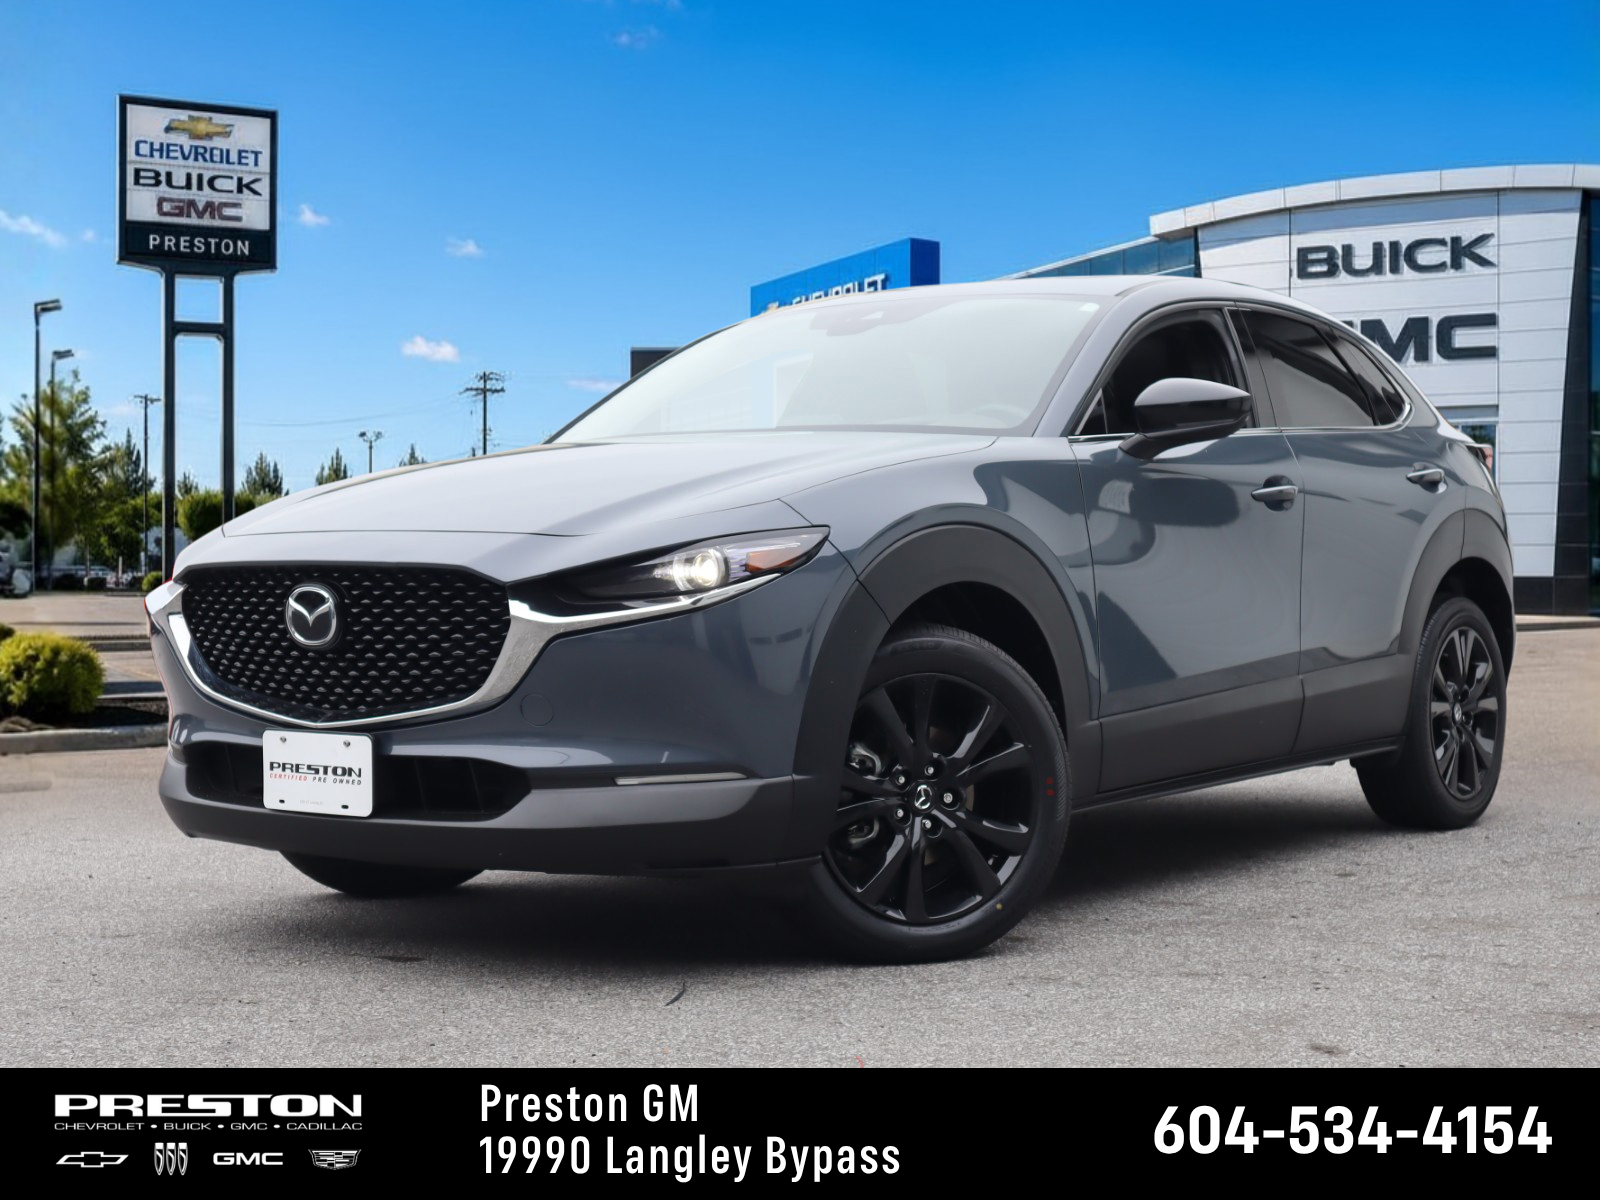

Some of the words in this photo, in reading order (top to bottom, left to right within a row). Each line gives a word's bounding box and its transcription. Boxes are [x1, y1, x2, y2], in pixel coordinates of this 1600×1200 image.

[135, 140, 263, 167] CHEVROLET
[133, 167, 262, 196] BUICK
[157, 196, 243, 222] GMC
[149, 234, 250, 255] PRESTON
[1297, 233, 1497, 280] BUICK
[1341, 313, 1497, 363] MC
[269, 761, 362, 778] PRESTON
[269, 773, 308, 782] CERTIFIED
[332, 778, 362, 786] OWNED
